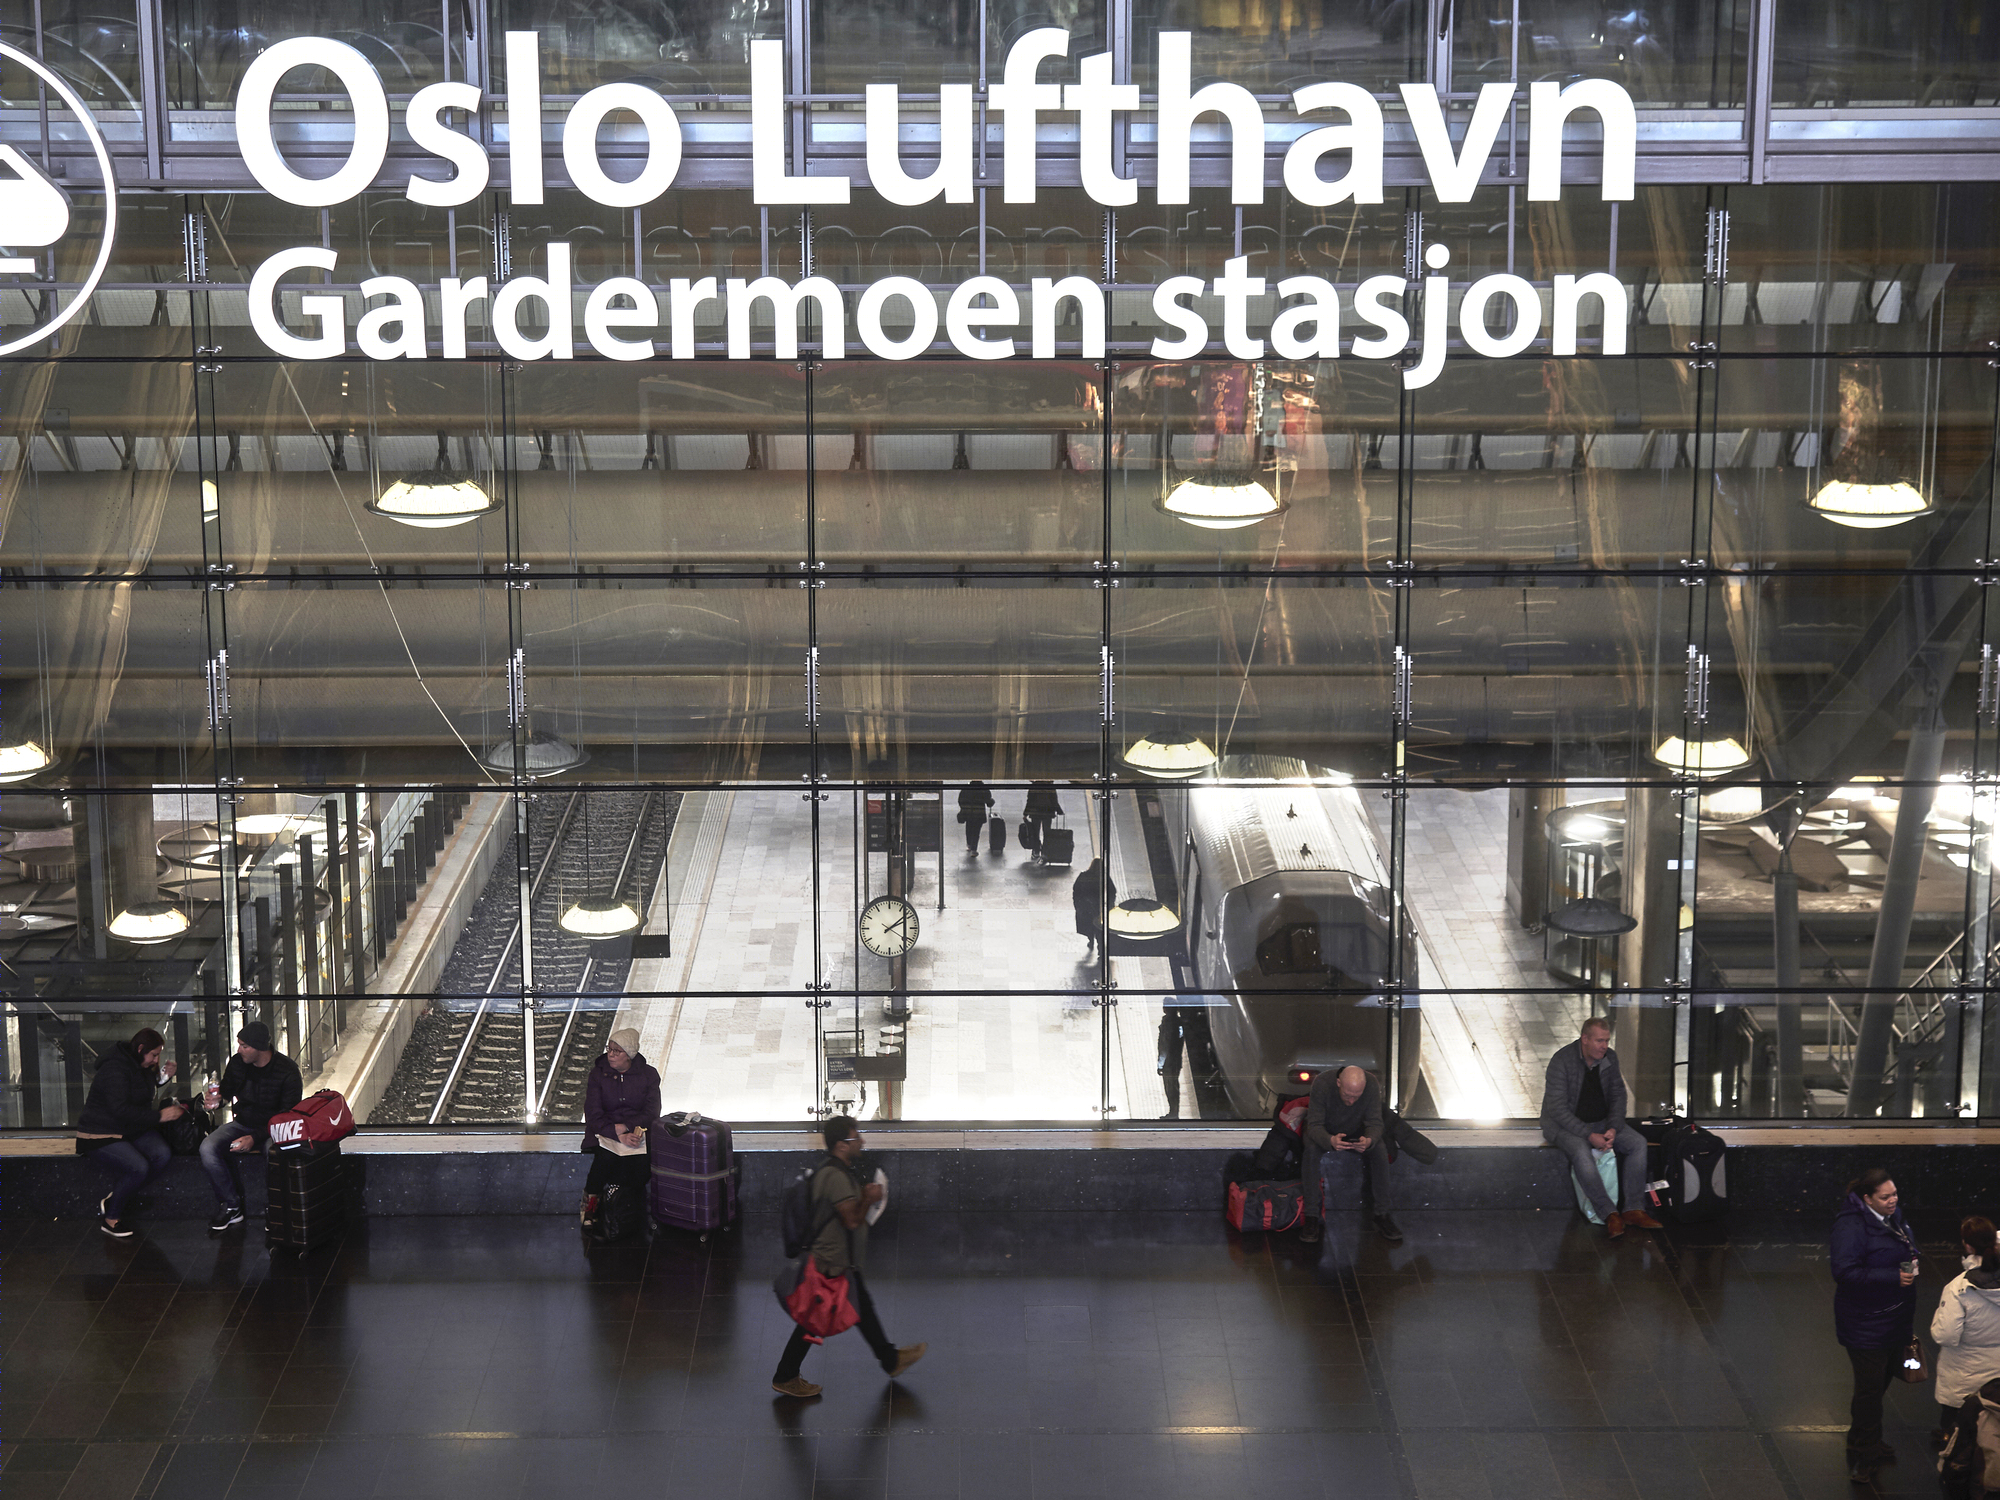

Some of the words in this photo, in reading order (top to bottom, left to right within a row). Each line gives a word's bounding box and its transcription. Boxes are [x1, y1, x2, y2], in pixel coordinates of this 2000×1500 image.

[236, 31, 681, 207] Oslo
[751, 28, 1637, 207] Lufthavn
[248, 243, 1106, 360] Gardermoen
[1151, 244, 1628, 389] stasjon
[270, 1119, 304, 1143] NIKE
